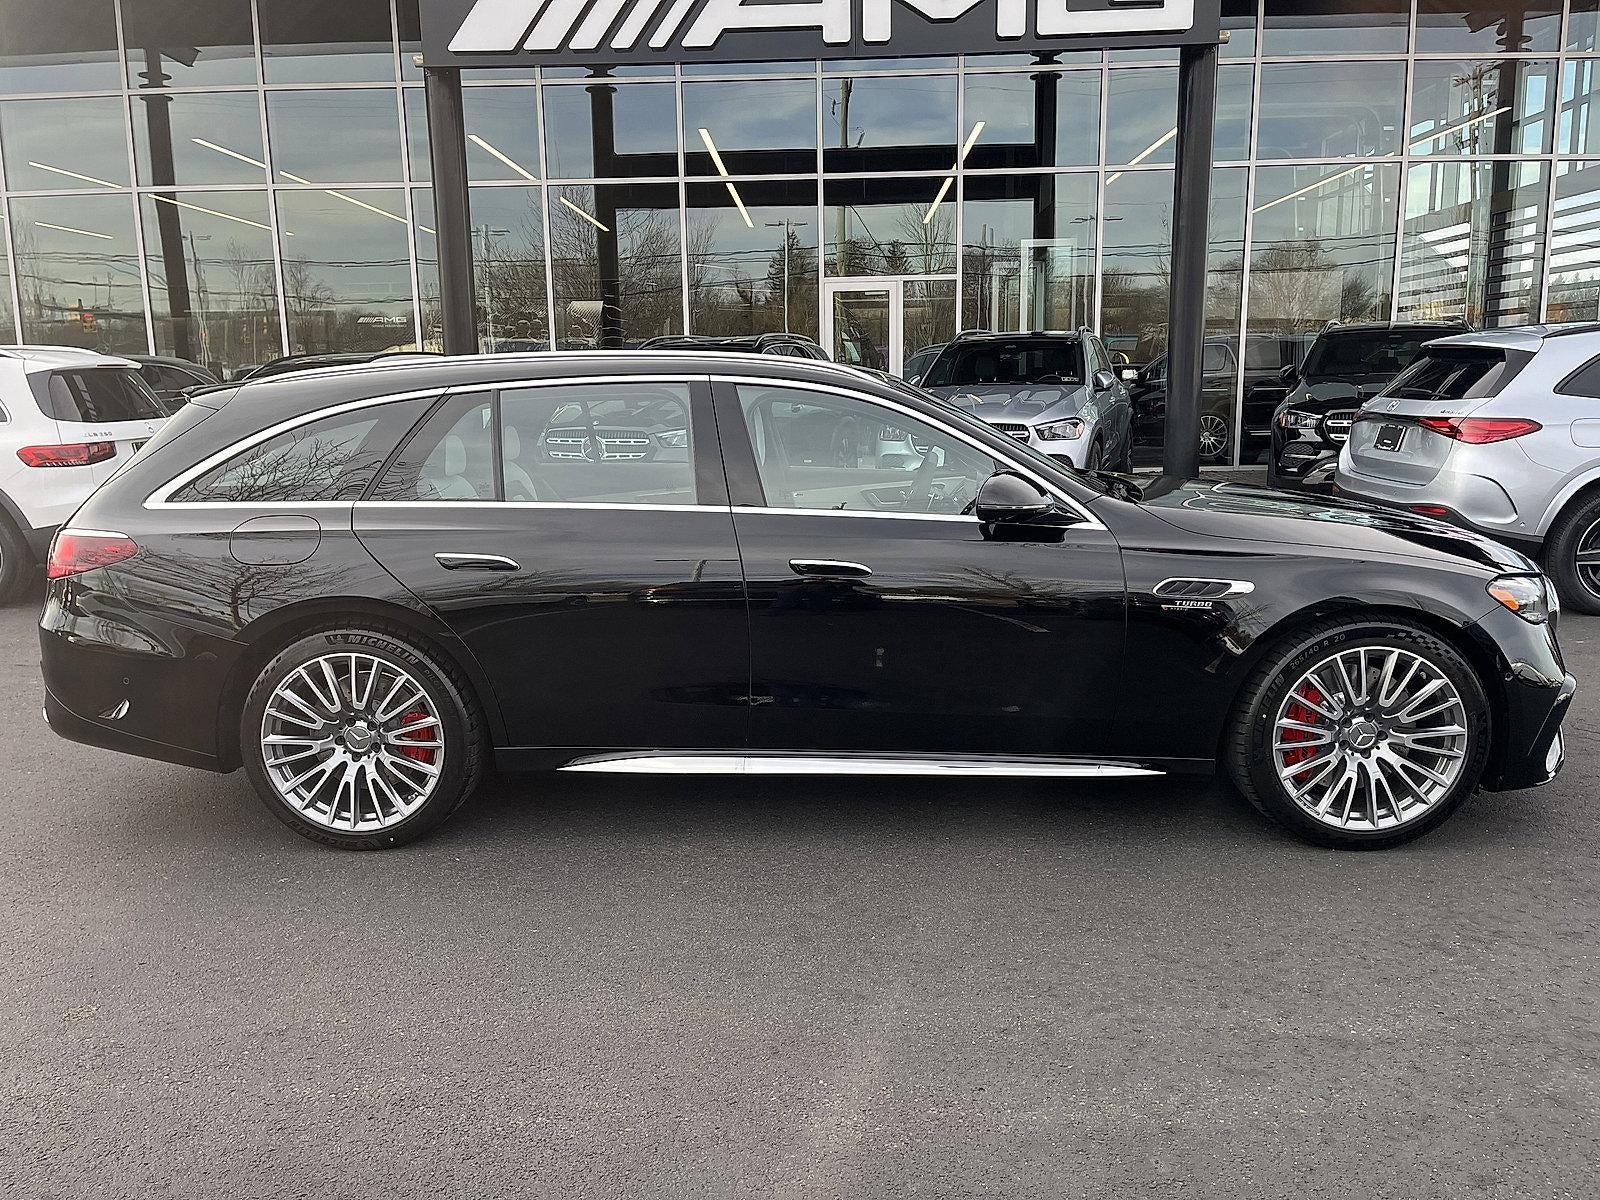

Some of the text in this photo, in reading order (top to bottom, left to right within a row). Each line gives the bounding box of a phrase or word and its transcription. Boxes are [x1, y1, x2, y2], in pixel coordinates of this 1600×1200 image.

[347, 634, 420, 666] MICHELIN
[1289, 645, 1319, 669] 265/40
[1333, 633, 1346, 643] 20
